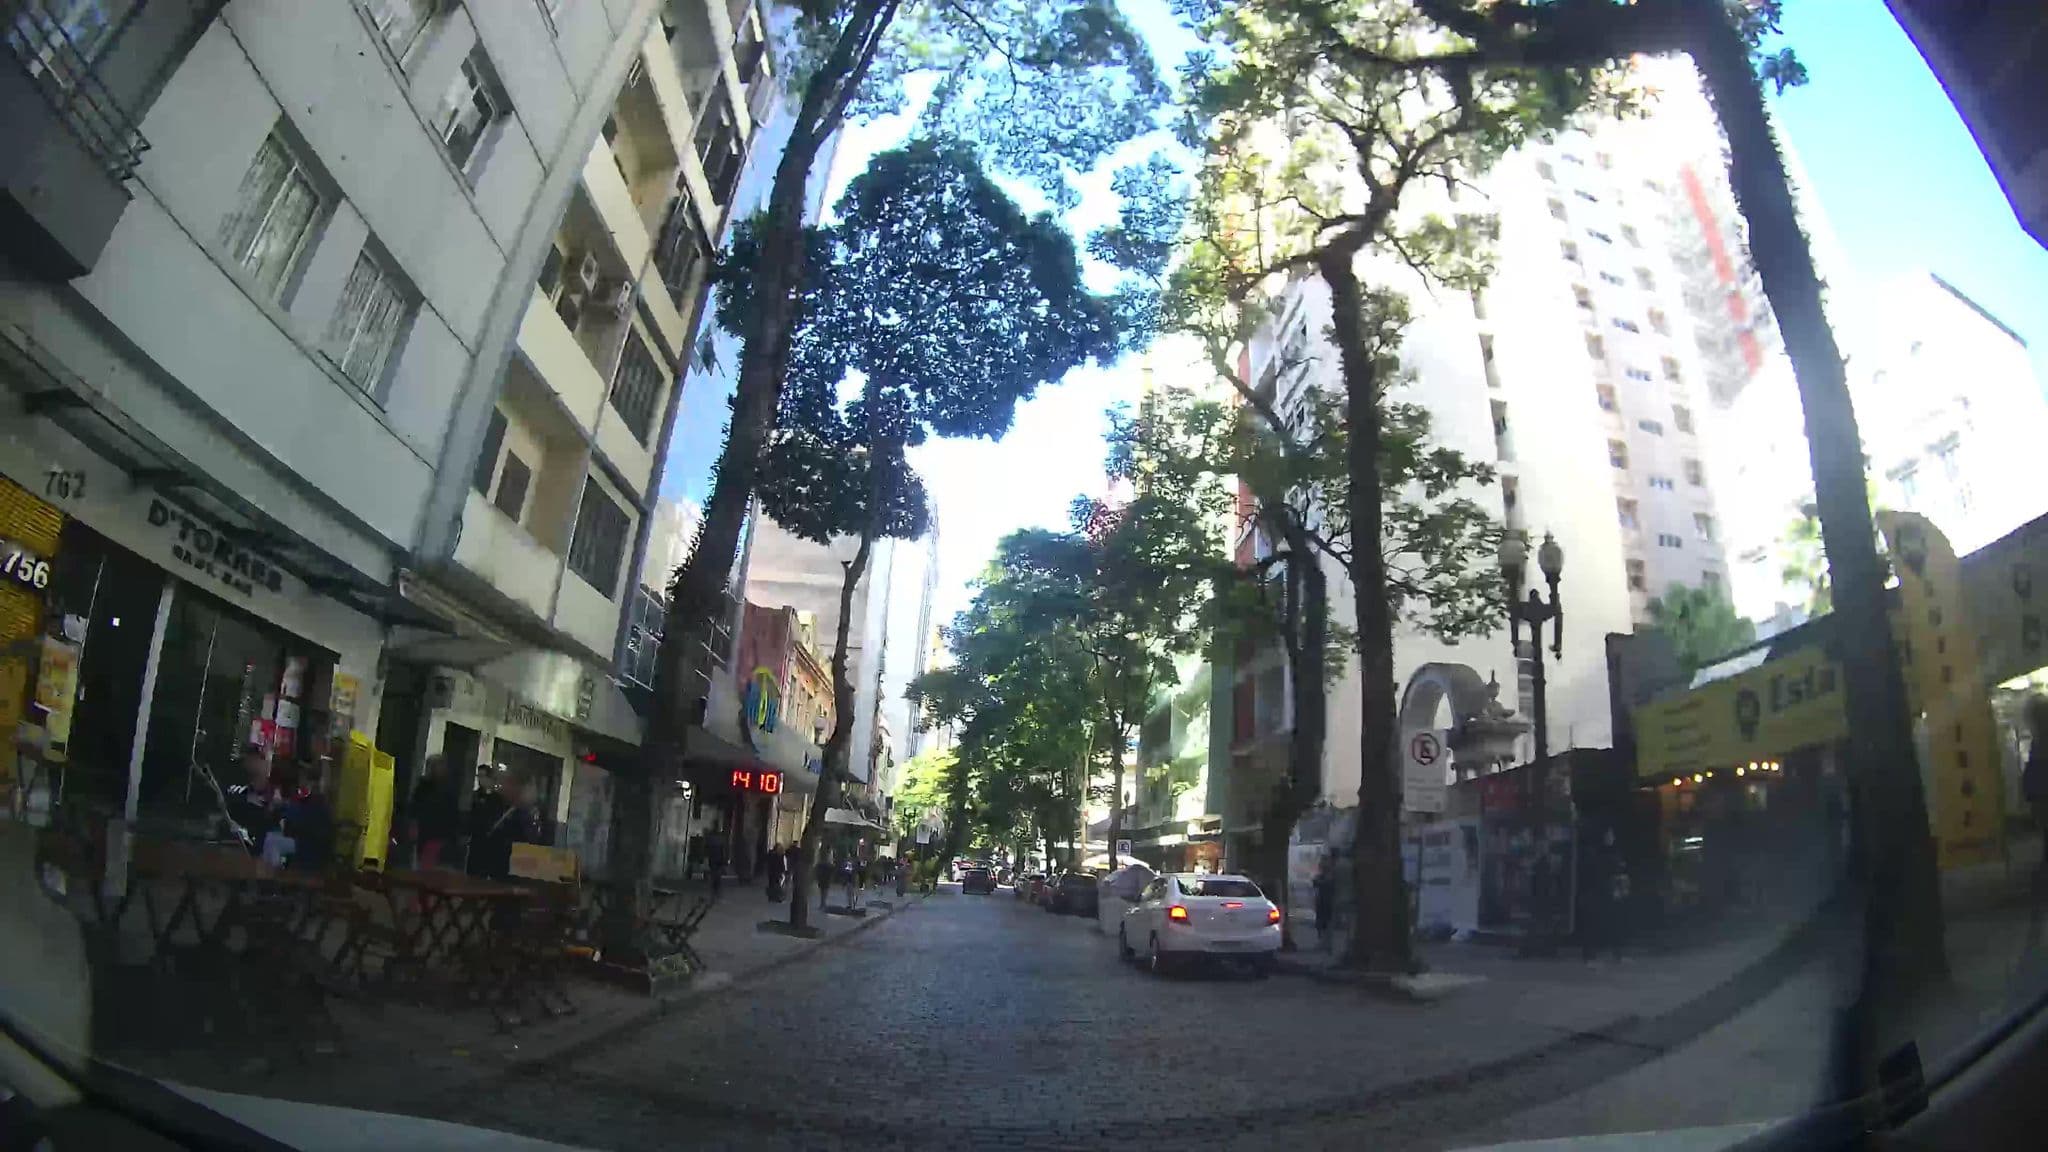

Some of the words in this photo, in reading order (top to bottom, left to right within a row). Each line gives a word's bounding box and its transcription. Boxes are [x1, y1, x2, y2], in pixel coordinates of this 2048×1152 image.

[43, 470, 86, 499] 762
[732, 770, 751, 789] 14
[759, 773, 777, 792] 10
